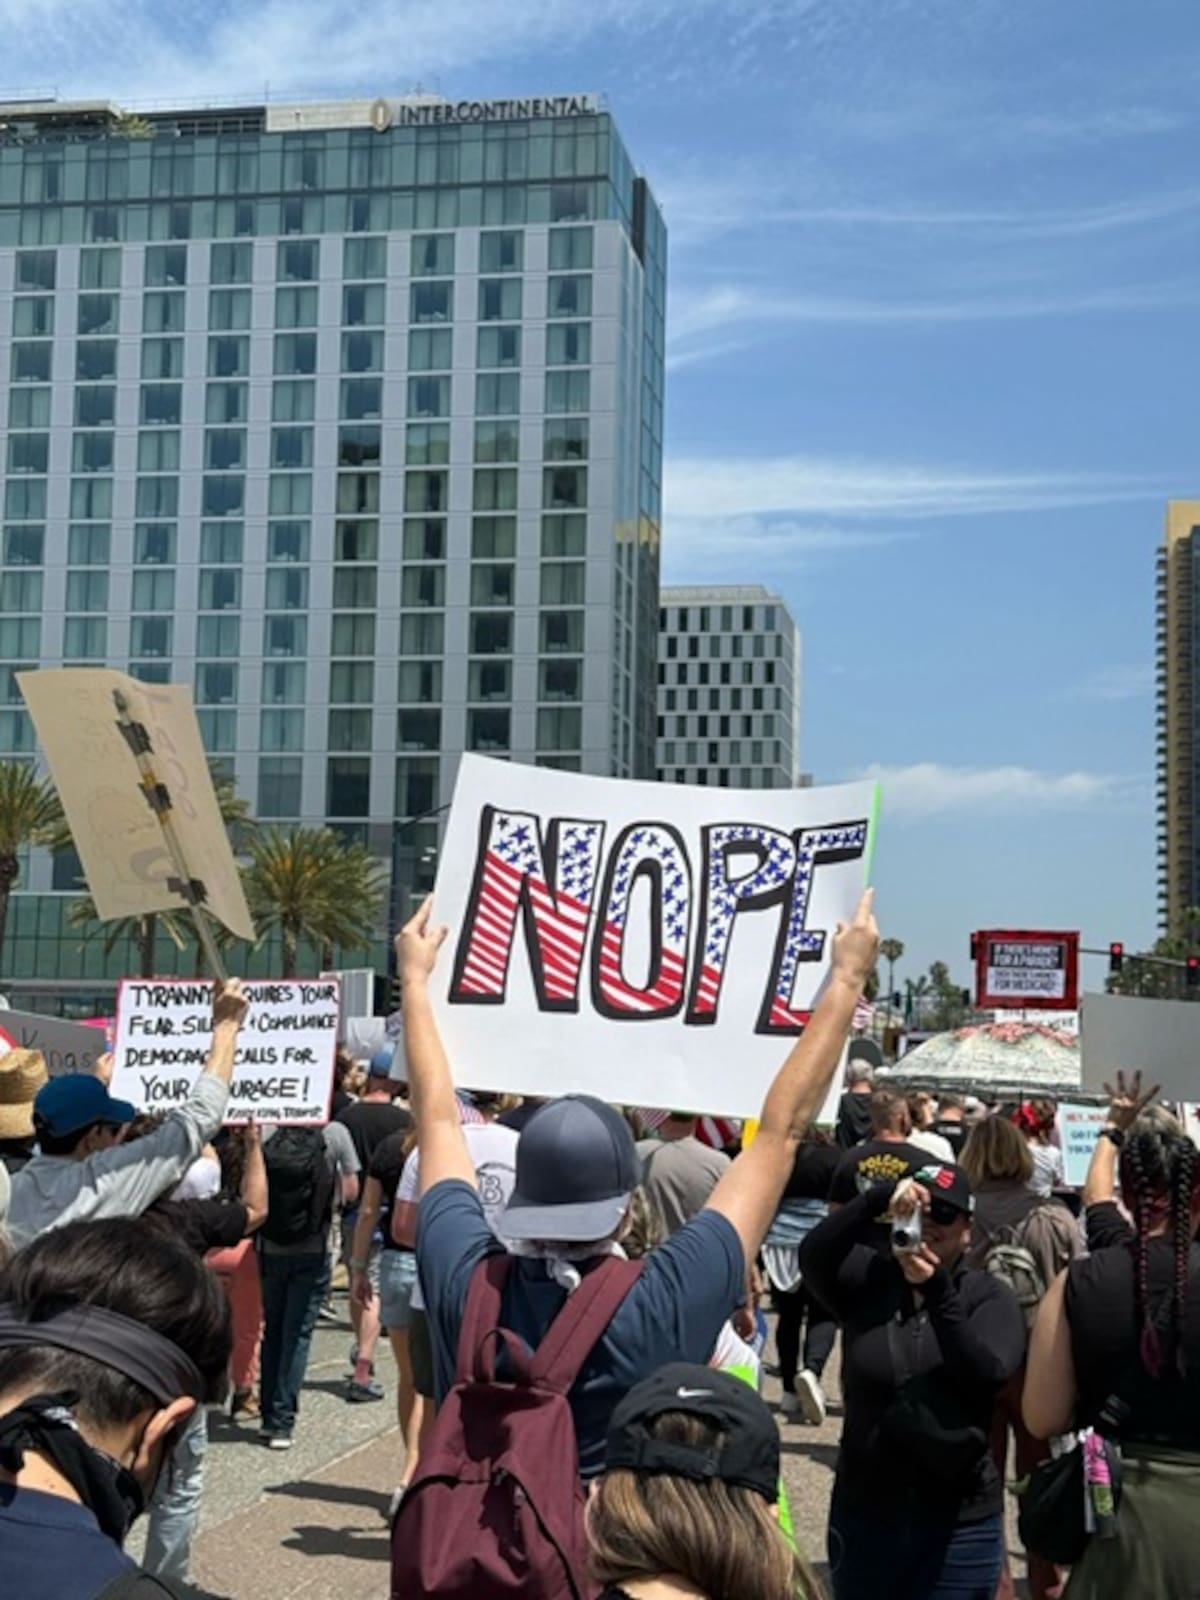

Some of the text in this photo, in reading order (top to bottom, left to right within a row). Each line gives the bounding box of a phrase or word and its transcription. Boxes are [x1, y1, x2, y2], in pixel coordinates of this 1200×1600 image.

[448, 803, 869, 1037] NOPE
[129, 985, 339, 1008] TYRANNY QUIRES YOUR
[257, 1012, 338, 1033] COMPLIANCE
[124, 1047, 318, 1068] DEMOCRAC CALLS FOR
[140, 1074, 191, 1102] YOUR
